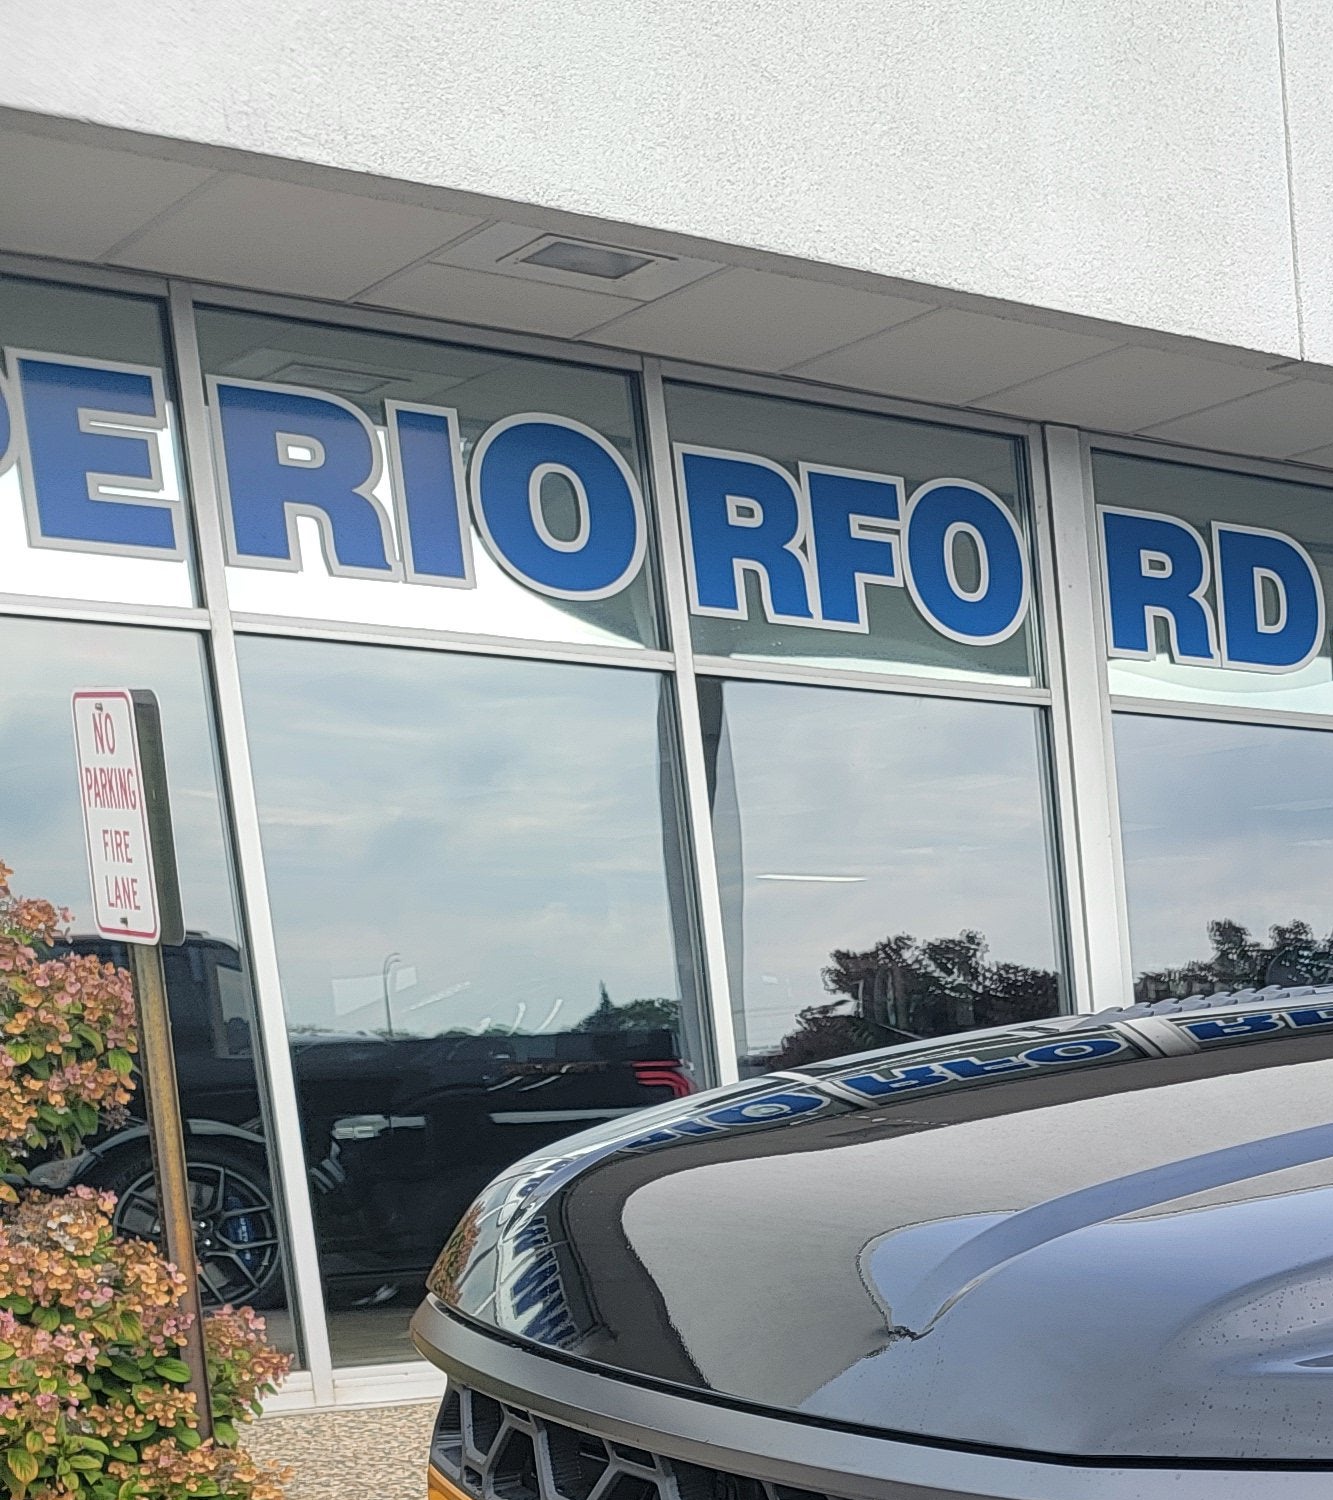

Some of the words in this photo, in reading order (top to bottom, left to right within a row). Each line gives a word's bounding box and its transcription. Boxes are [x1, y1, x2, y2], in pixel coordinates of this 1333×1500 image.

[92, 713, 115, 754] NO
[84, 767, 137, 811] PARKING
[102, 829, 133, 863] FIRE
[105, 875, 141, 910] LANE
